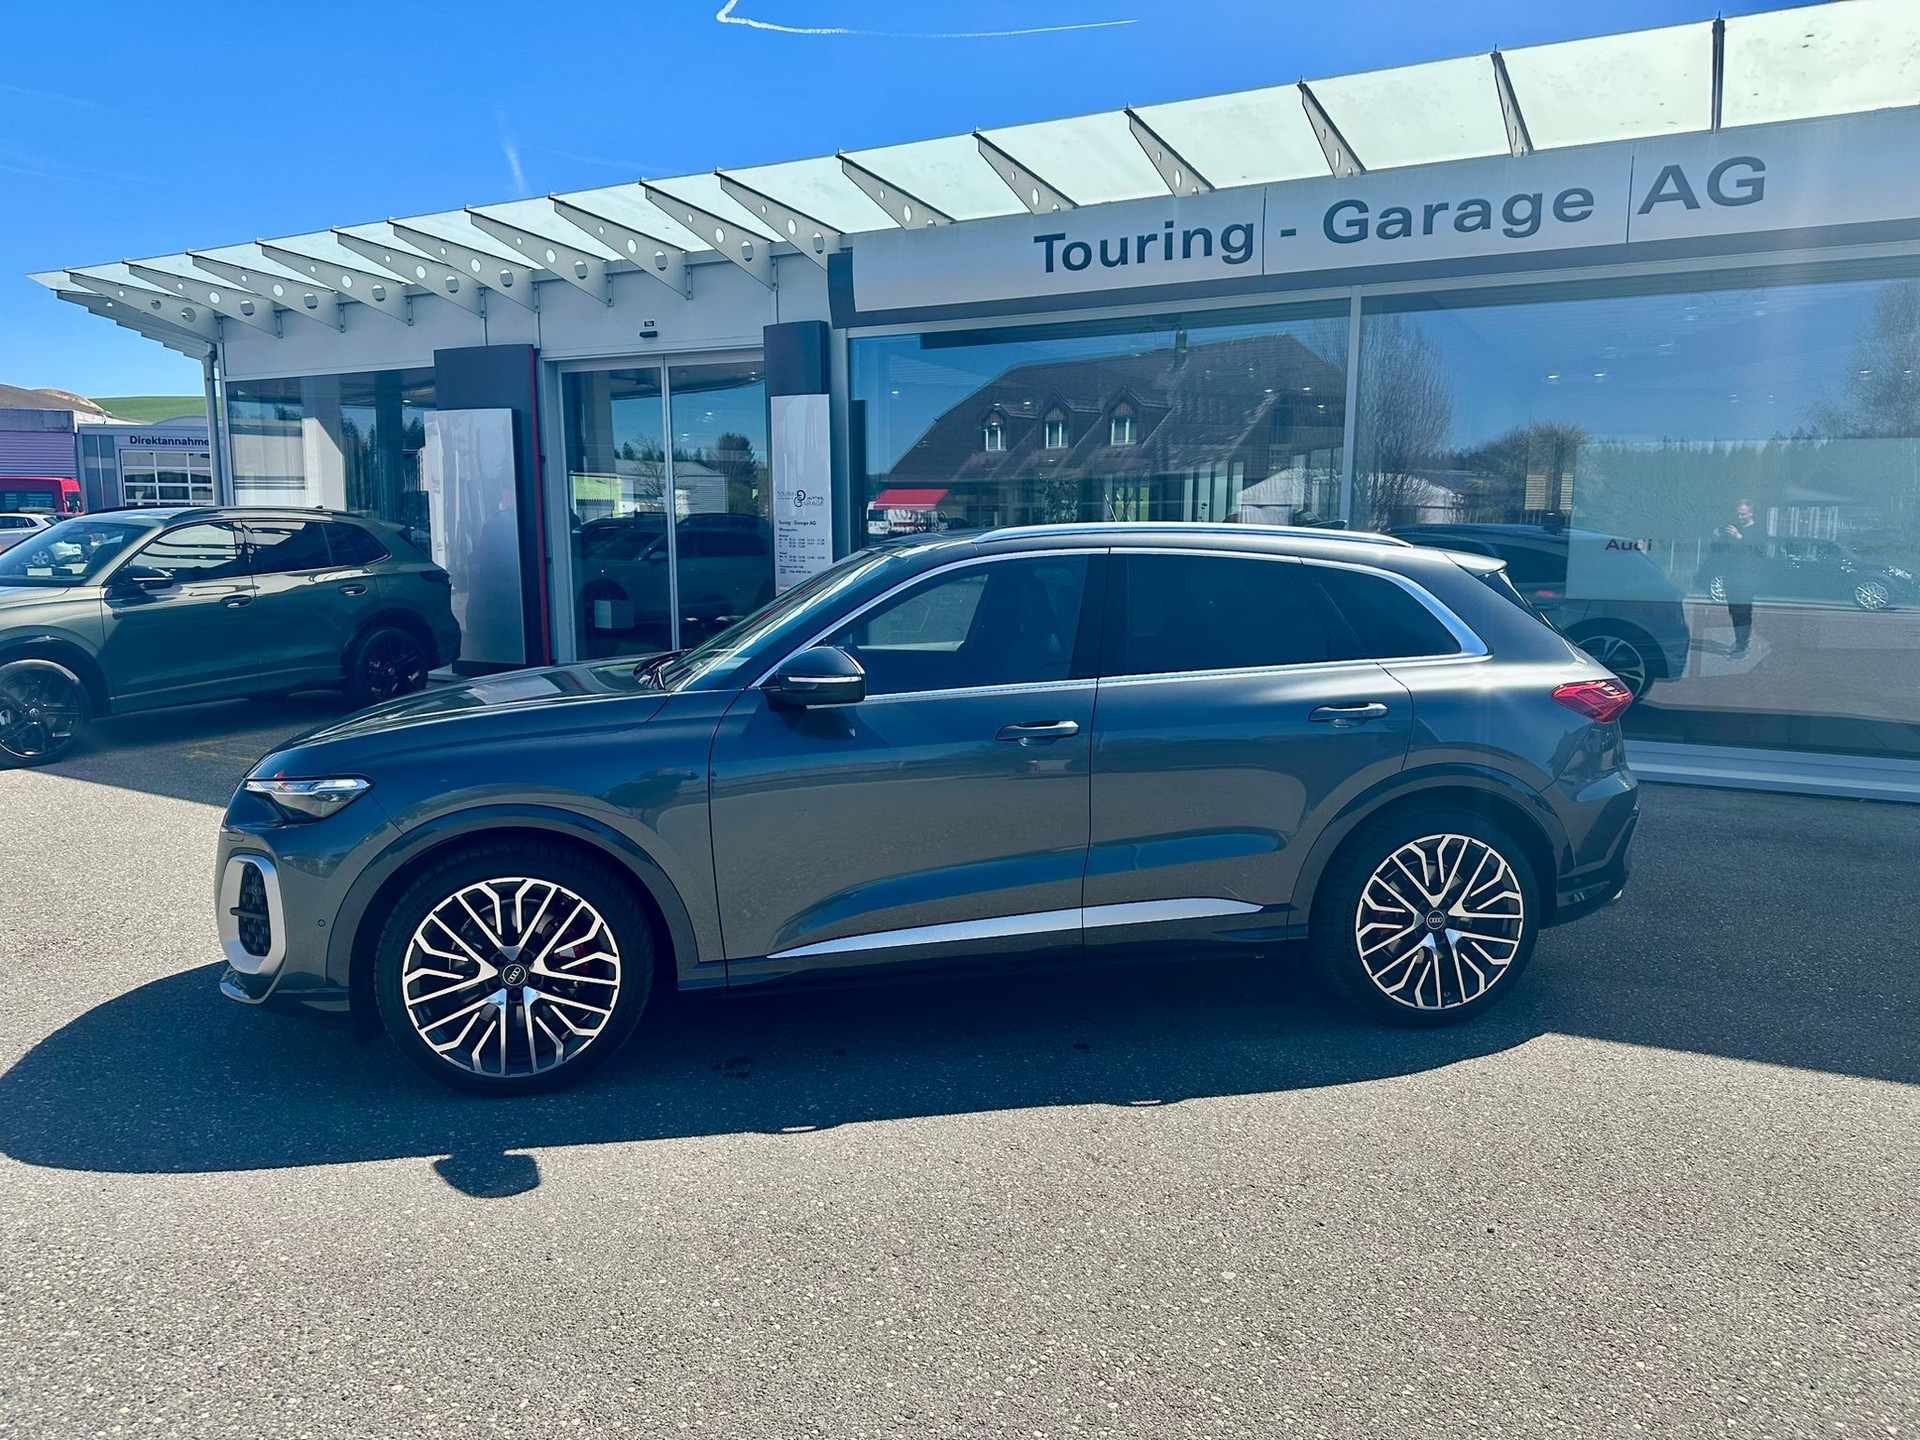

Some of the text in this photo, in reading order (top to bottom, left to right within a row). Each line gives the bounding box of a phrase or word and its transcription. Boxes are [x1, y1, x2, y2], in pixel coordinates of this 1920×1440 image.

[1033, 220, 1255, 273] Touring
[1323, 187, 1595, 243] Garage
[1637, 156, 1766, 215] AG
[129, 435, 210, 447] Direktannahme
